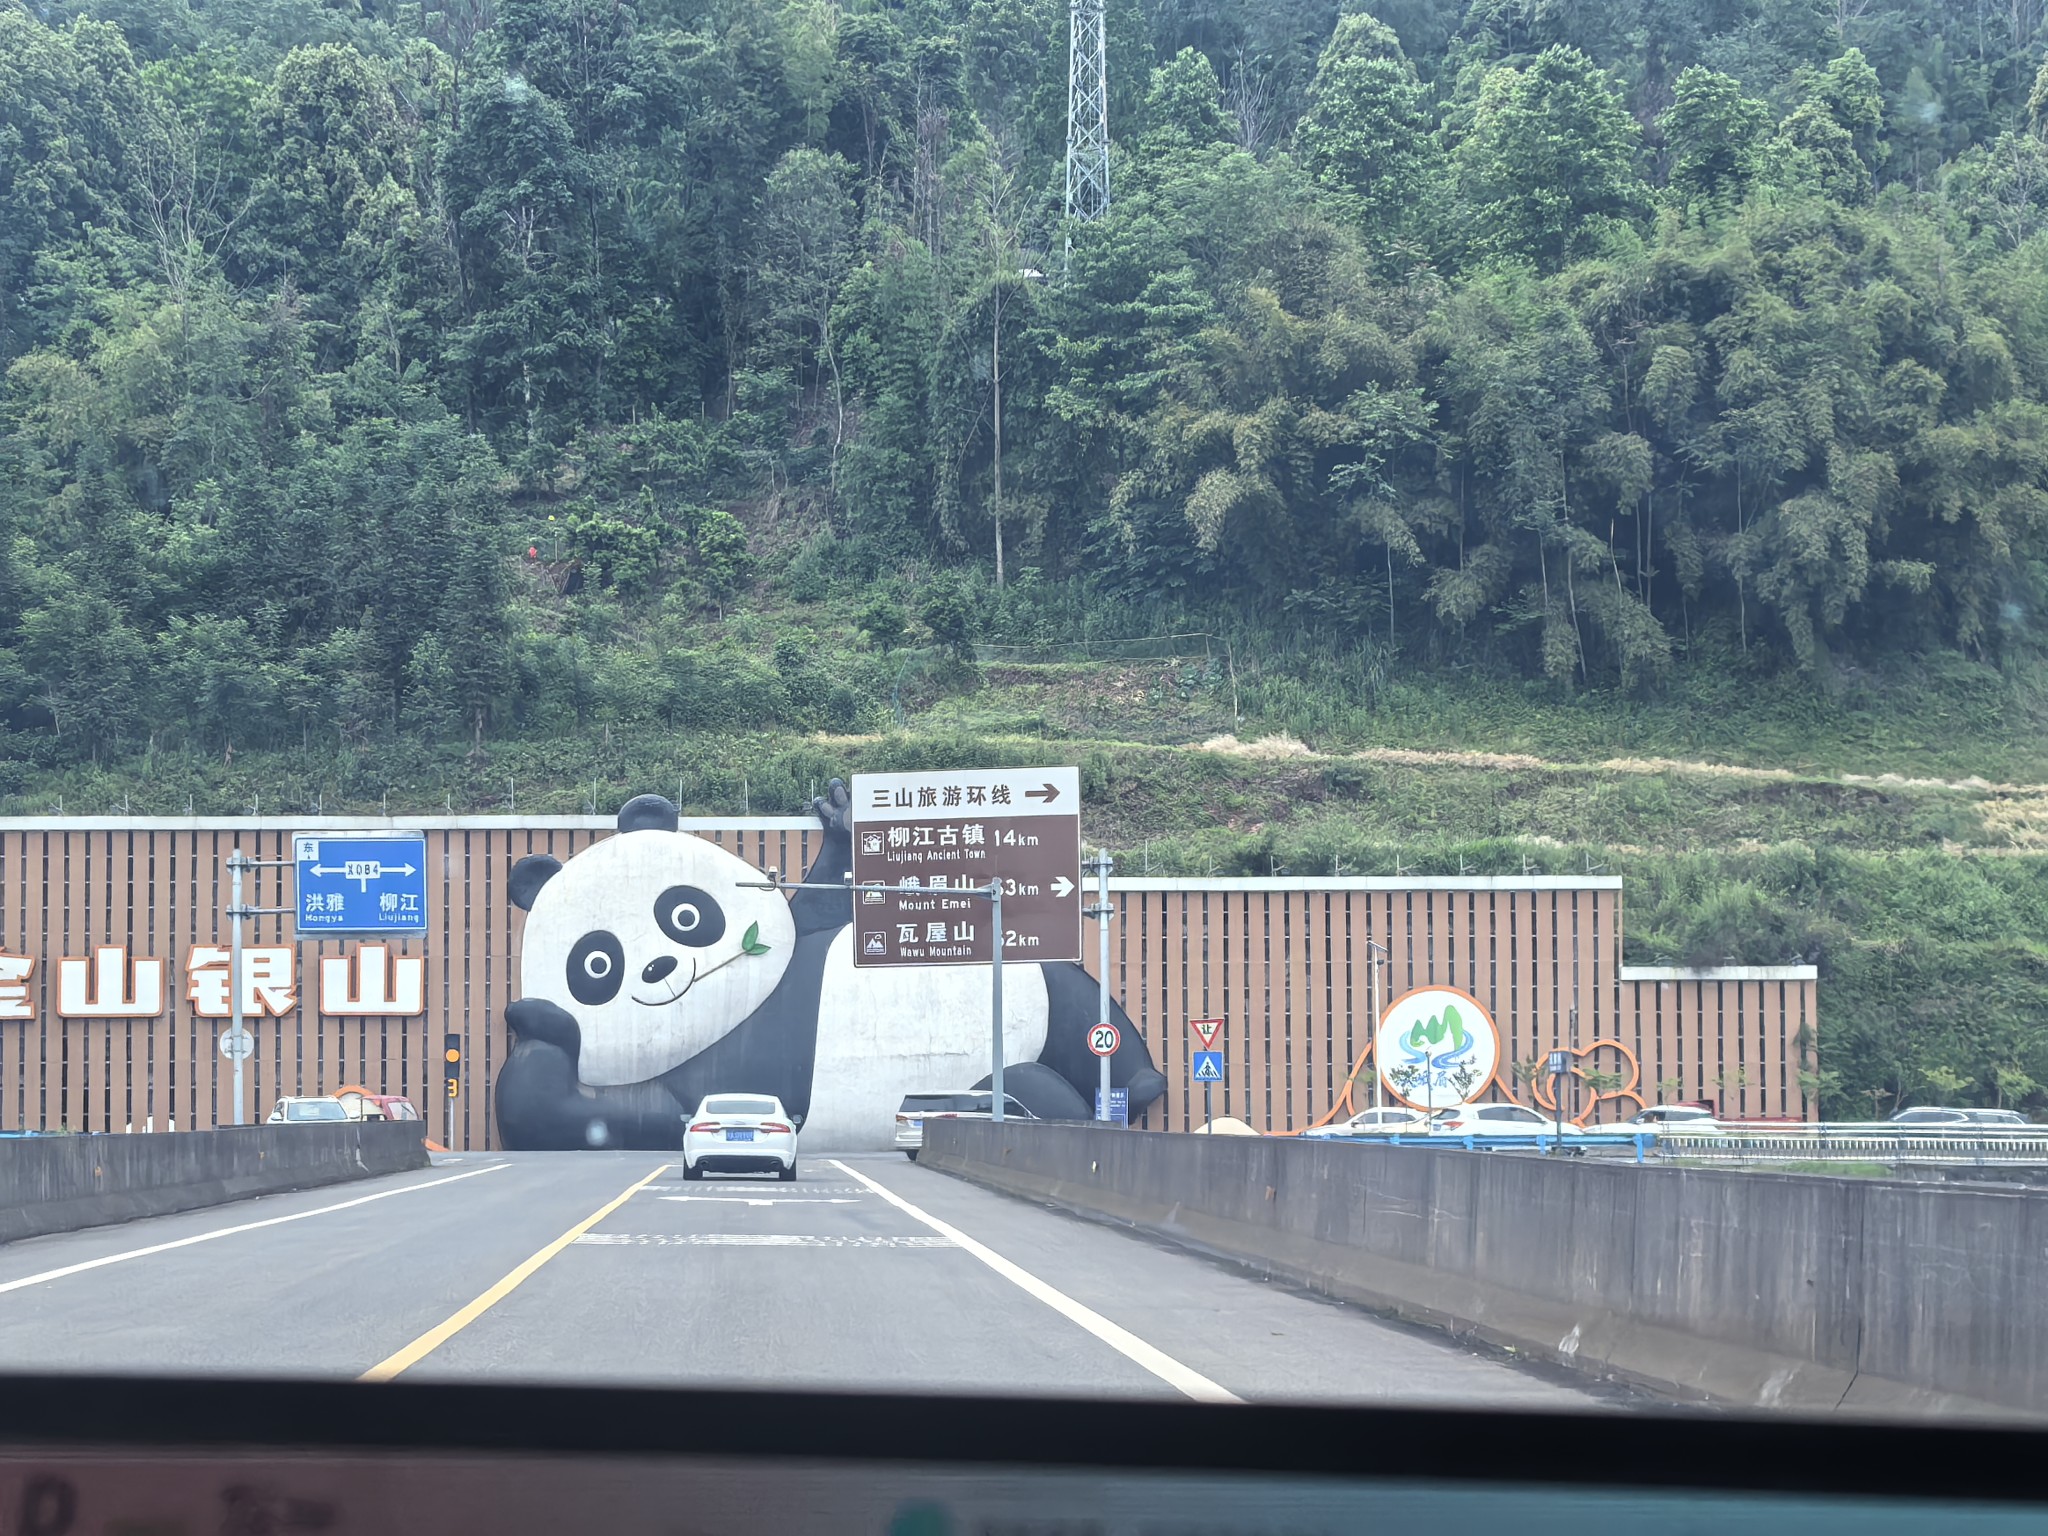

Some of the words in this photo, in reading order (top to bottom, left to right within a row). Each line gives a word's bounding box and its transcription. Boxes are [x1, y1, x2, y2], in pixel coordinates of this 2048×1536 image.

[872, 784, 1012, 808] 三山旅游环线
[887, 823, 985, 847] 柳江古镇
[994, 829, 1039, 847] 14km
[303, 842, 314, 853] 东
[887, 851, 923, 864] Liujiang
[927, 849, 961, 861] Ancient
[964, 848, 986, 860] Town
[999, 879, 1039, 896] 3km
[305, 892, 345, 912] 洪雅
[379, 892, 419, 912] 柳江
[899, 899, 936, 911] Mount
[941, 897, 971, 910] Emei
[379, 913, 419, 923] Liujiang
[896, 921, 975, 944] 瓦屋山
[1000, 930, 1040, 947] 2km
[900, 947, 925, 957] Wawu
[929, 944, 972, 957] Mountain
[1200, 1024, 1213, 1035] 让
[1095, 1030, 1114, 1049] 20
[447, 1078, 458, 1097] 3
